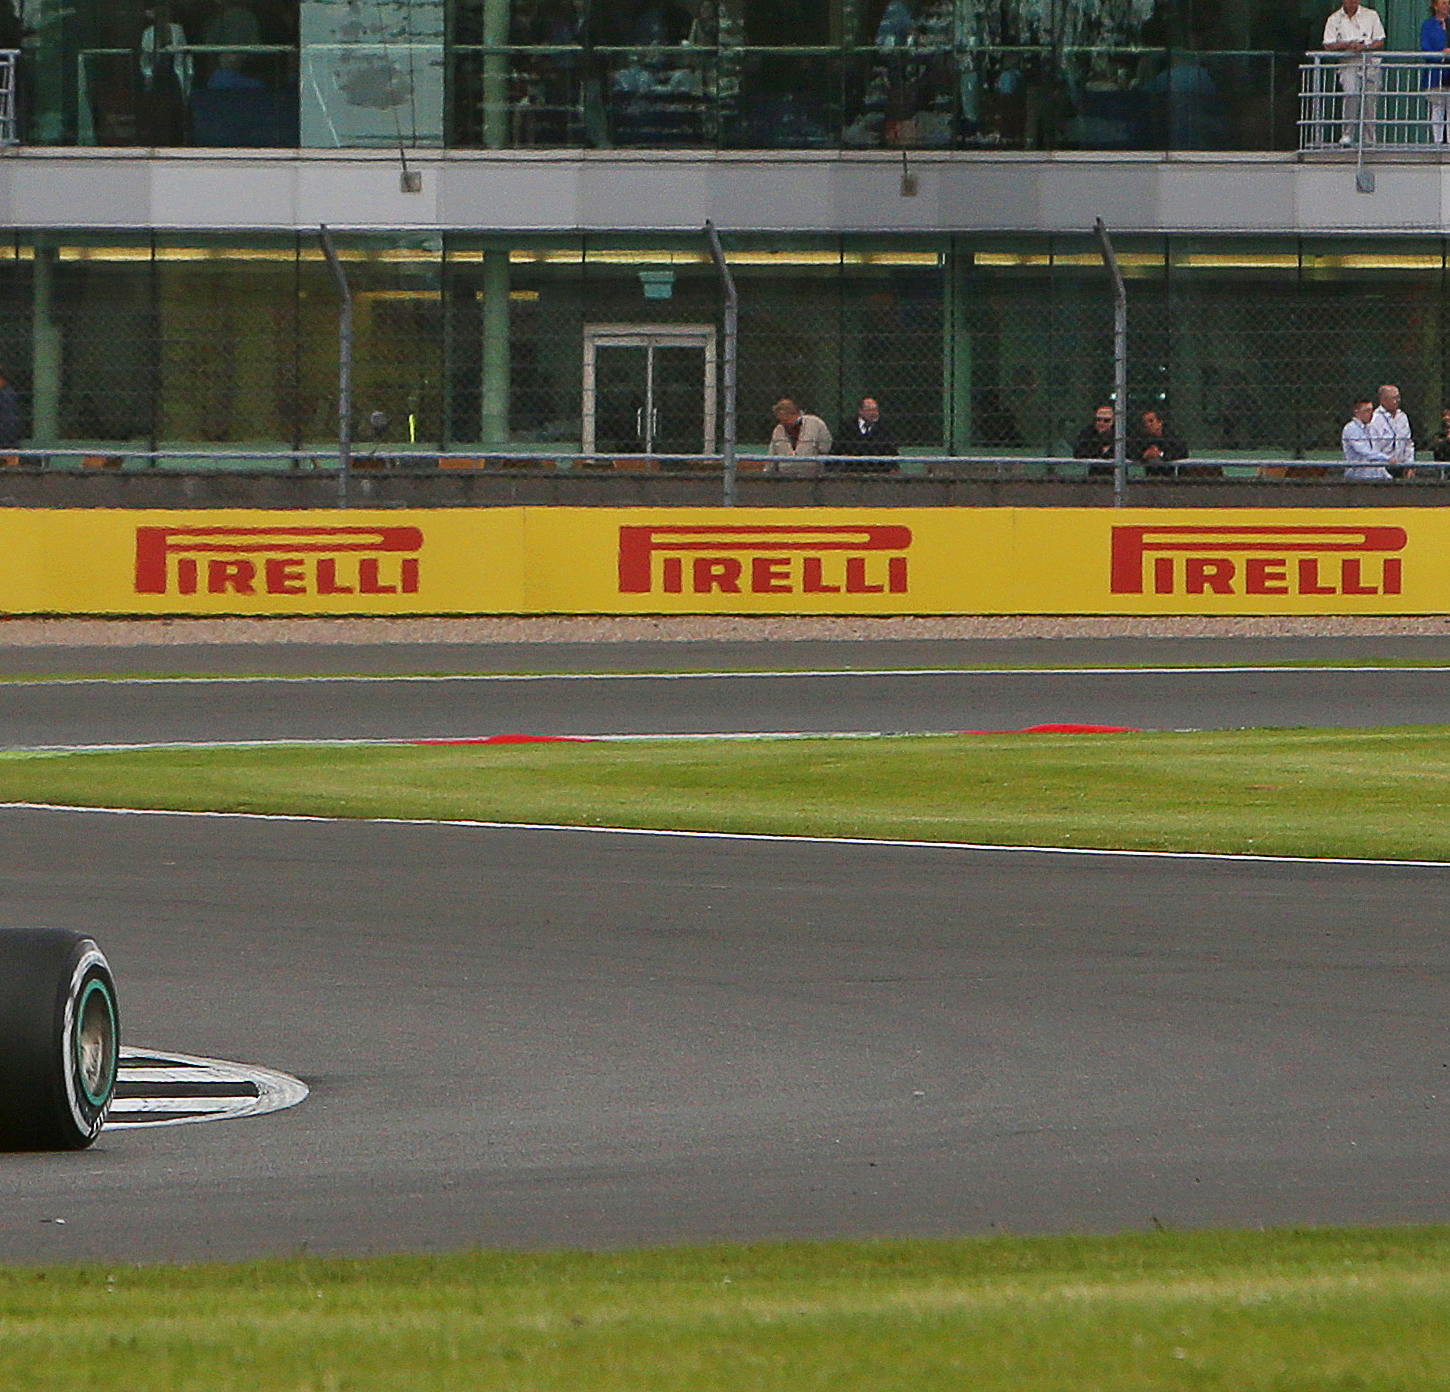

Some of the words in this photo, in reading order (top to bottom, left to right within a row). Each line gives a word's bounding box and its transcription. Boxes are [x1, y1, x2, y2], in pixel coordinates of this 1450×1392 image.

[134, 526, 424, 595] PIRELLI
[618, 525, 913, 594] PIRELLI
[1110, 525, 1408, 595] PIRELLI
